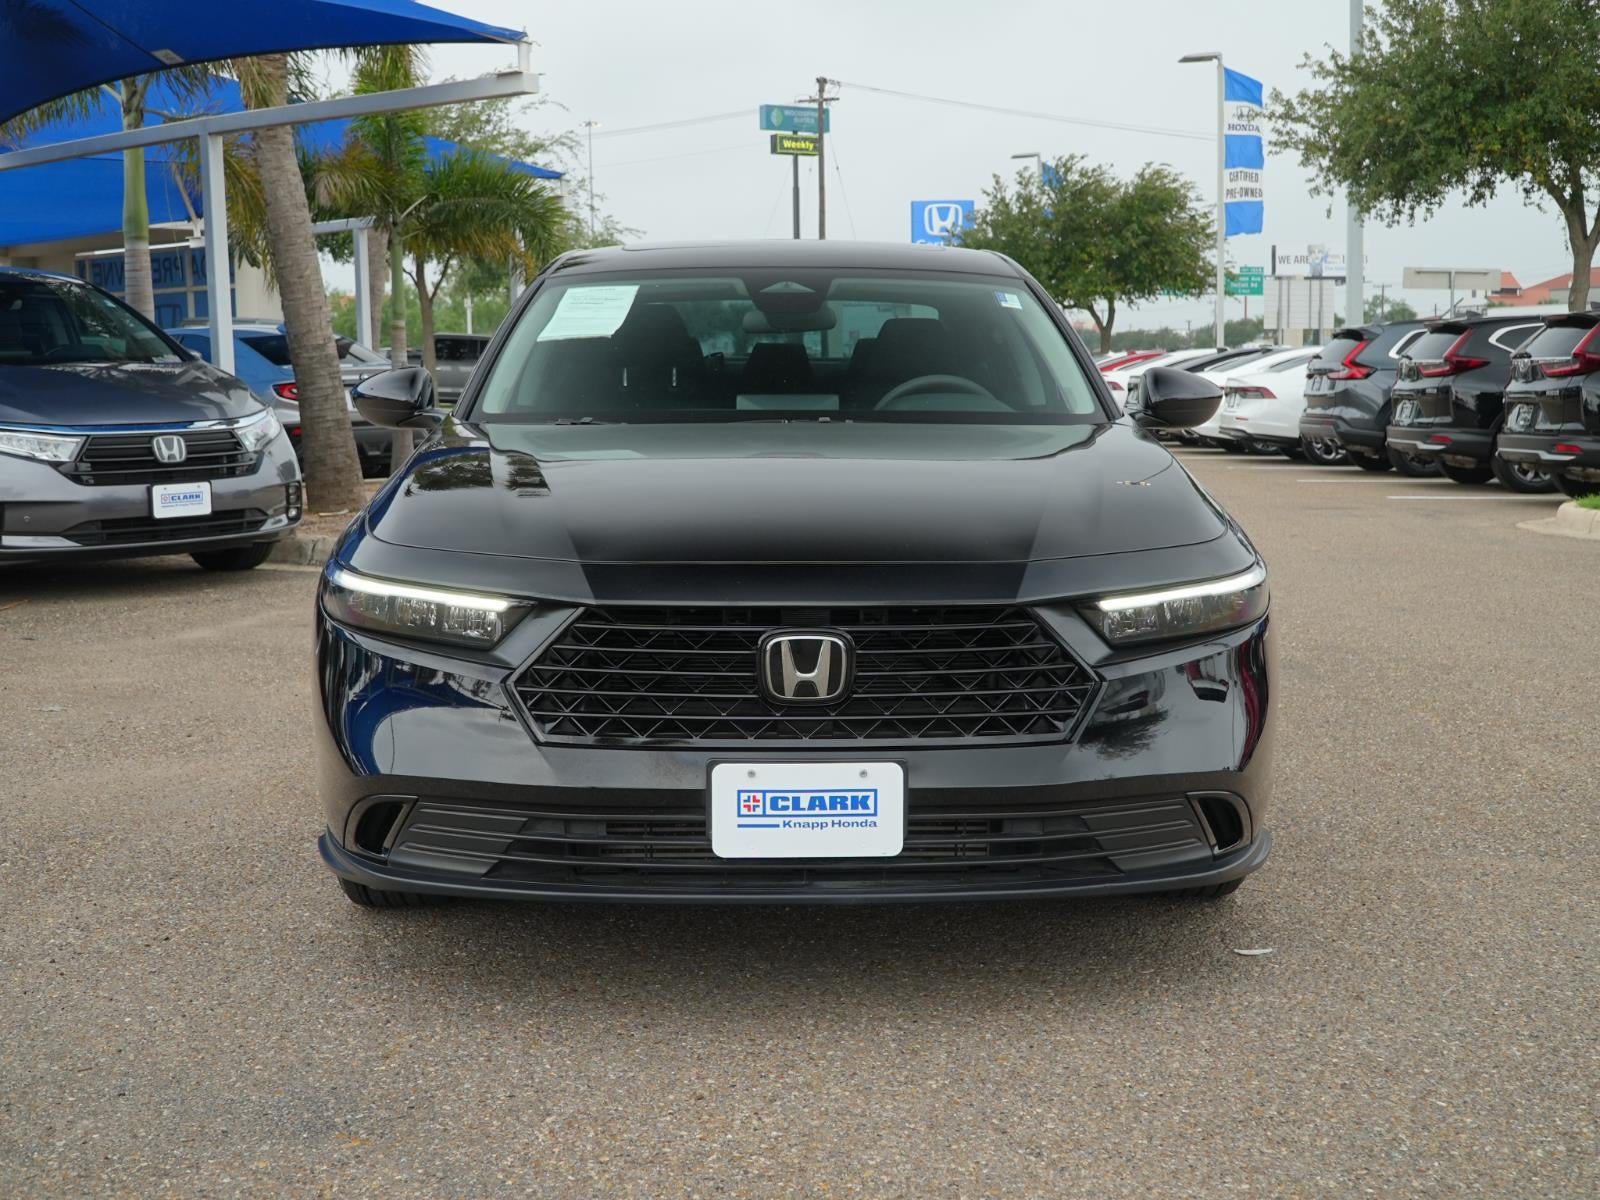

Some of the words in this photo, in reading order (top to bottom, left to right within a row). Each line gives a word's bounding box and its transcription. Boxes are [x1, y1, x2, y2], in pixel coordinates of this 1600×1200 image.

[1228, 123, 1260, 133] HONDA
[783, 139, 814, 151] Weekly
[1229, 170, 1259, 183] CERTIFIED
[1226, 187, 1263, 199] PRE-OWNED
[1278, 256, 1292, 265] WE
[1294, 256, 1311, 265] ARE
[769, 795, 871, 812] CLARK
[783, 819, 828, 831] Knapp
[831, 819, 878, 829] Honda
